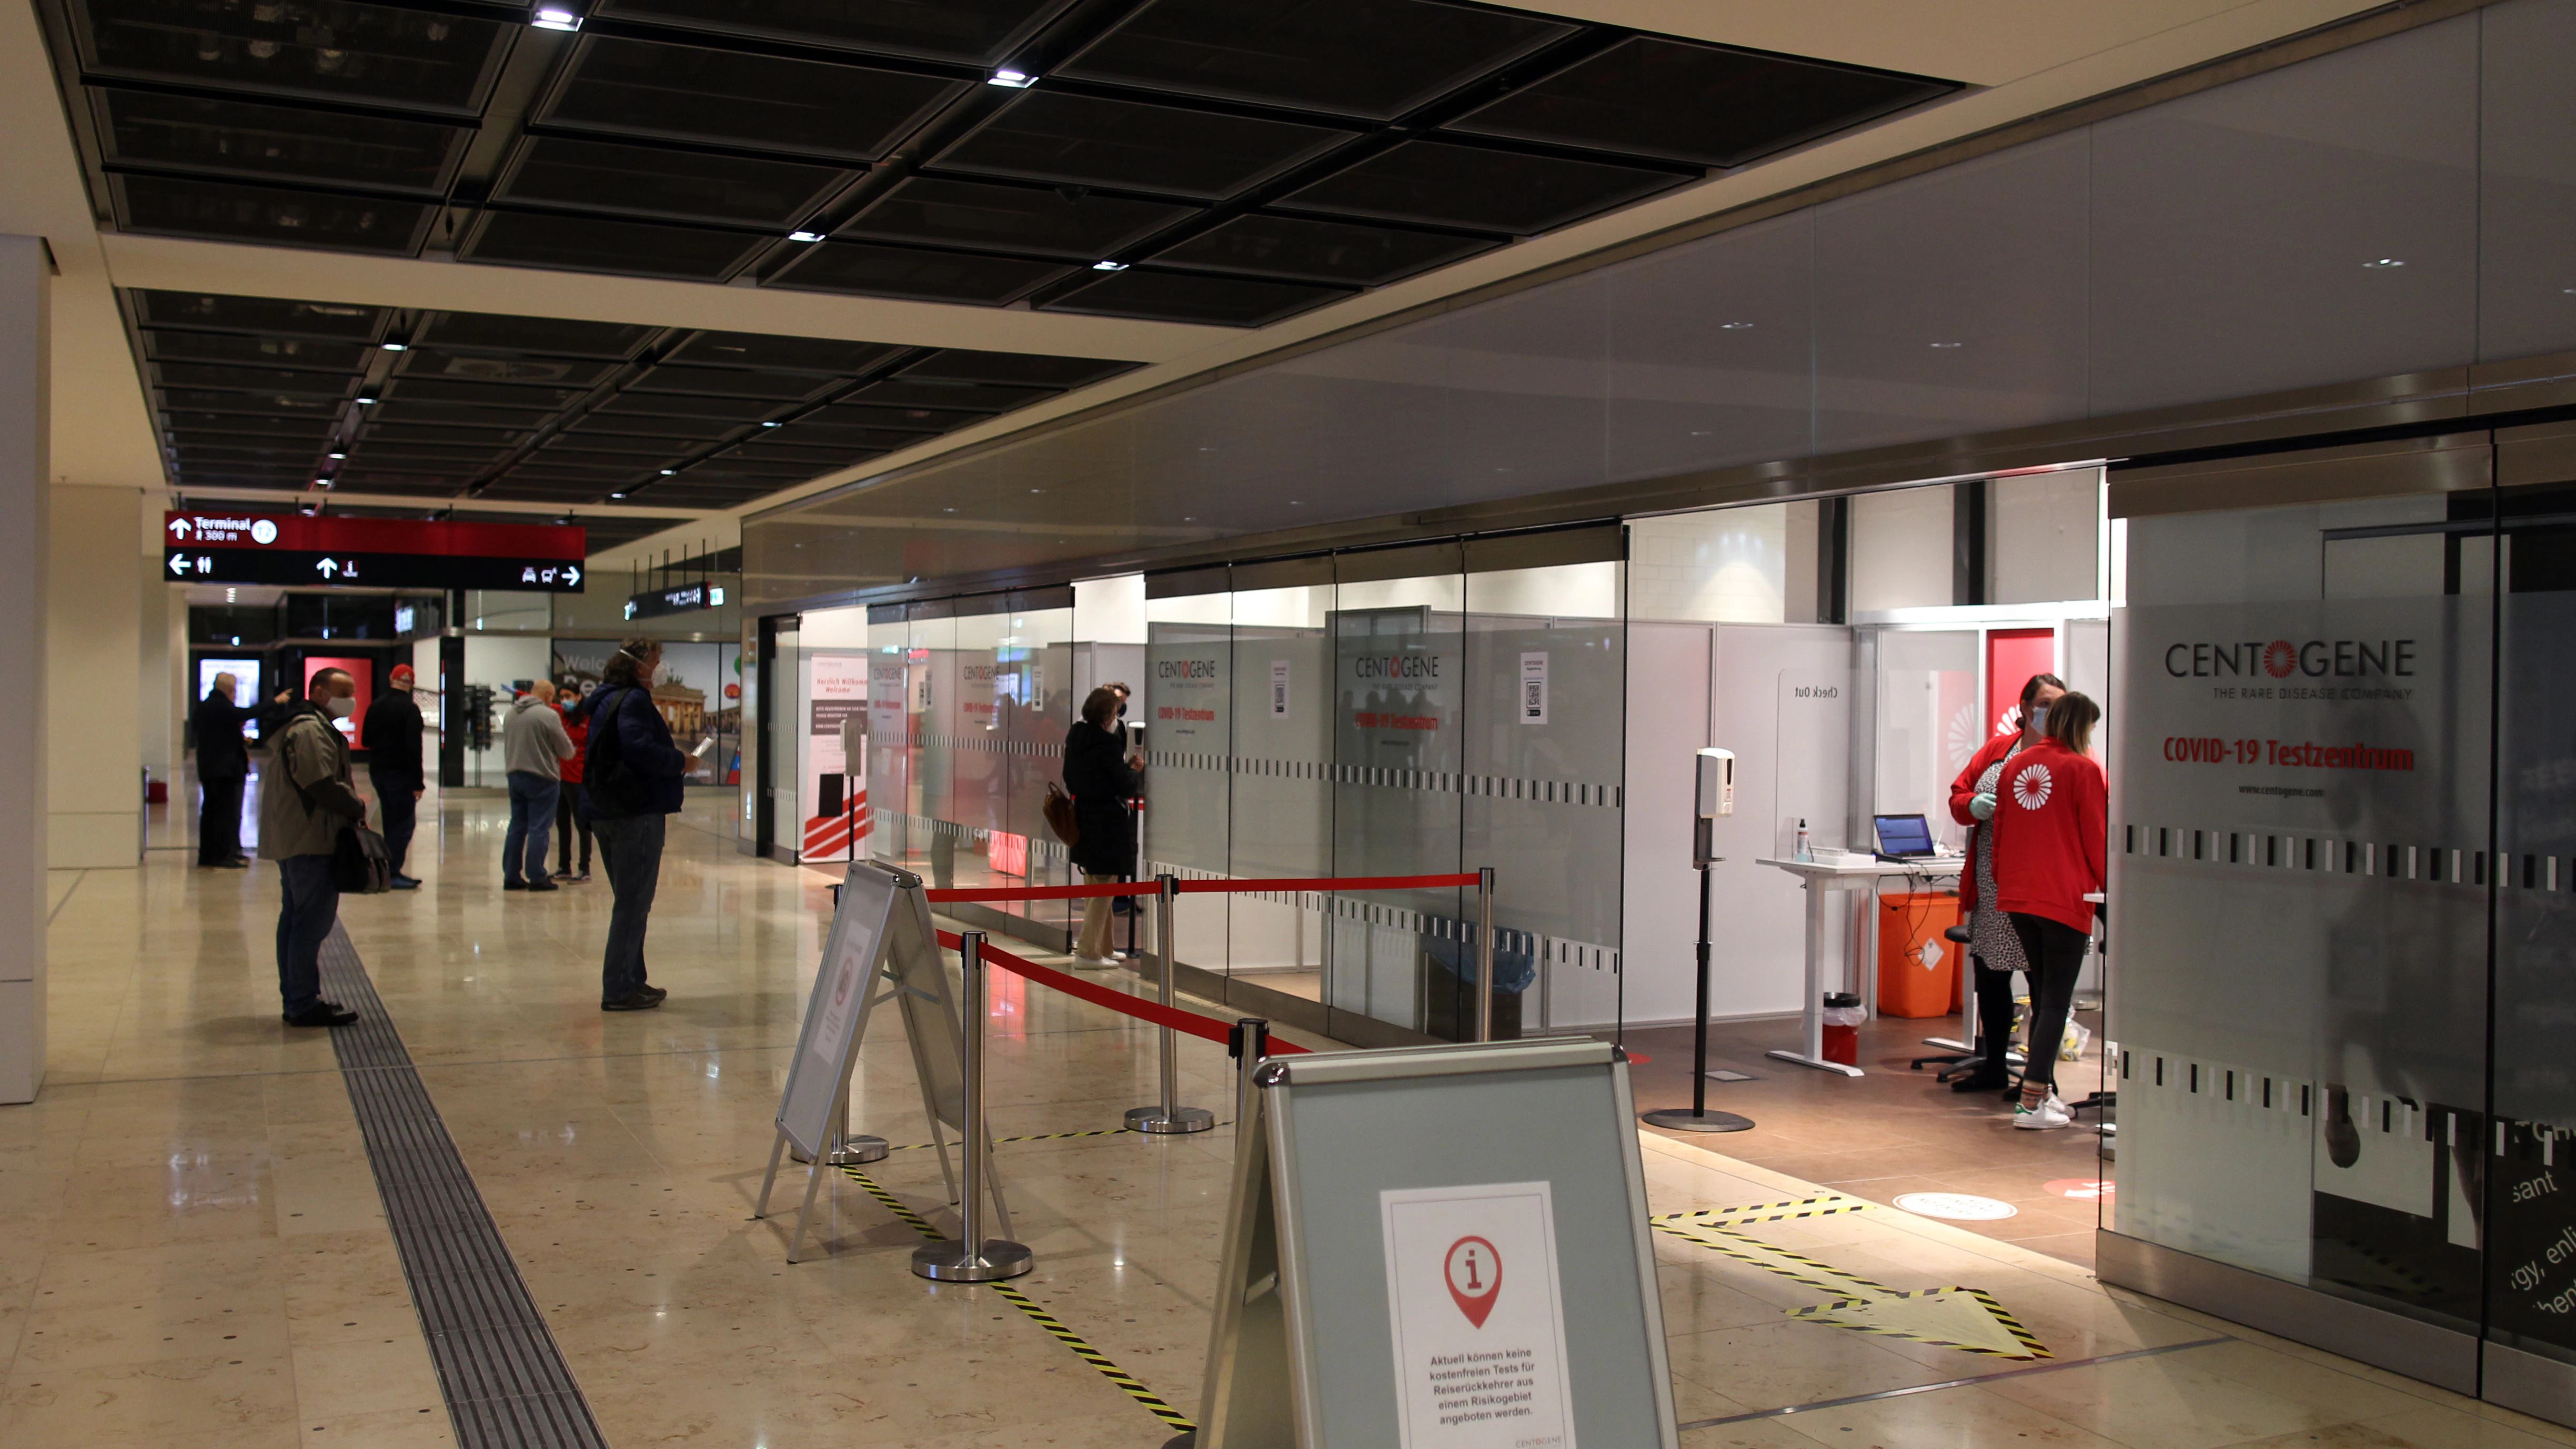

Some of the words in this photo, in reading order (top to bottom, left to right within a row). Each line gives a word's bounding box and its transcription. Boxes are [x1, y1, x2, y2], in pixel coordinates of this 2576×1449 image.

[194, 517, 251, 530] Terminal
[226, 532, 238, 541] m
[1356, 656, 1439, 678] CENTOGENE
[2165, 640, 2415, 678] CENTOGENE
[873, 667, 901, 680] CENTOGENE
[963, 666, 1000, 680] CENTOGENE
[1159, 660, 1215, 678] CENTOGENE
[2213, 688, 2235, 699] THE
[2241, 688, 2273, 699] RARE
[2279, 688, 2334, 700] DISEASE
[2341, 688, 2412, 700] COMPANY
[1158, 707, 1181, 719] COVID-19
[1182, 708, 1214, 720] Testzentrum
[1355, 712, 1389, 728] COVID-19
[1391, 713, 1438, 730] Testzentrum
[2164, 737, 2260, 764] COVID-19
[2266, 739, 2414, 771] Testzentrum
[2238, 784, 2324, 799] www.centogene.com
[1431, 1354, 1464, 1367] Aktuell
[1467, 1352, 1504, 1364] können
[1506, 1347, 1532, 1360] keine
[1430, 1367, 1491, 1382] kostenfreien
[1493, 1363, 1519, 1375] Tests
[1522, 1361, 1536, 1373] für
[1434, 1379, 1514, 1396] Reiserückkehrer
[1516, 1377, 1534, 1387] aus
[1438, 1398, 1468, 1411] einem
[1471, 1392, 1532, 1406] Risikogebiet
[1440, 1410, 1492, 1426] angeboten
[1495, 1406, 1533, 1420] werden.
[1515, 1435, 1563, 1448] CENTOGENE
